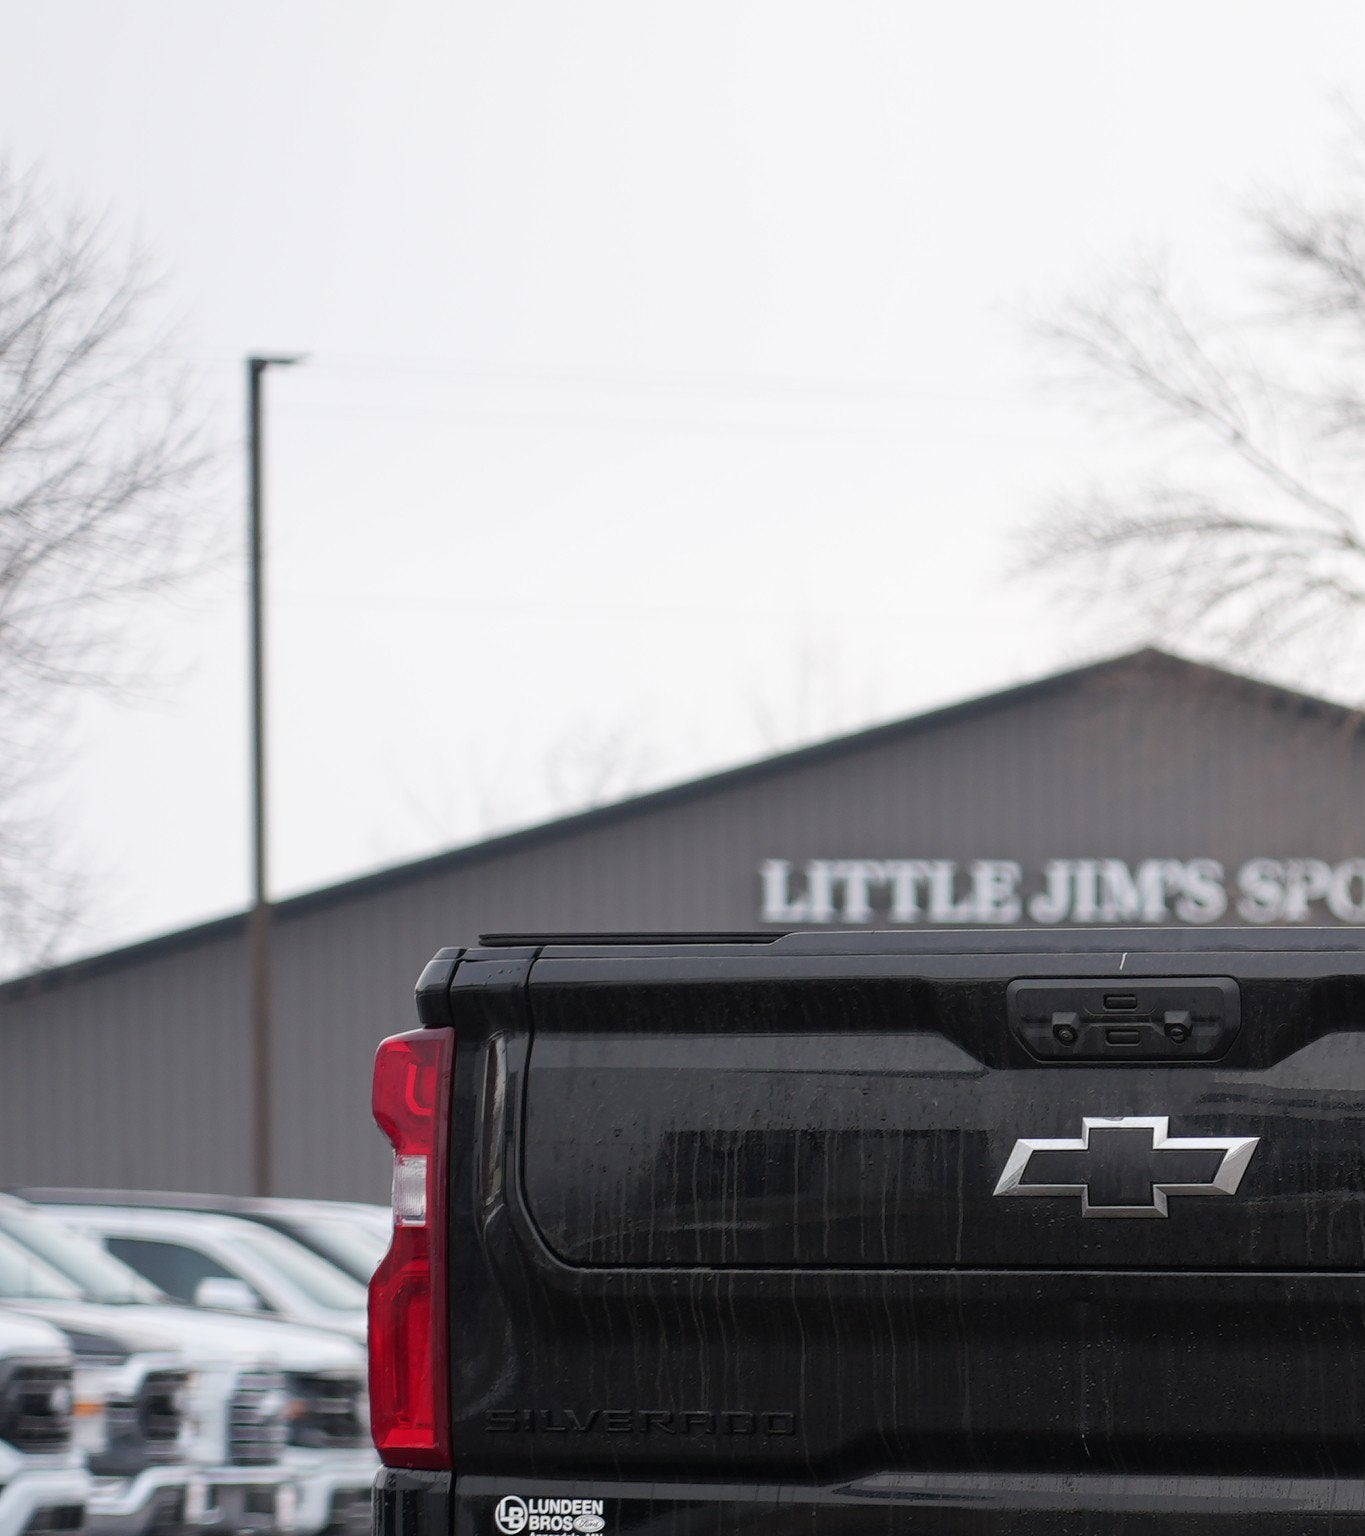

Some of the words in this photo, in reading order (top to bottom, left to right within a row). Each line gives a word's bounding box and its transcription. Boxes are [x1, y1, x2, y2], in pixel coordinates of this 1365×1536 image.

[760, 858, 1024, 924] LITTLE
[1030, 857, 1228, 924] JIM'S
[483, 1408, 798, 1437] SILVERADO
[528, 1498, 604, 1515] LUNDEEN
[528, 1515, 574, 1532] BROS
